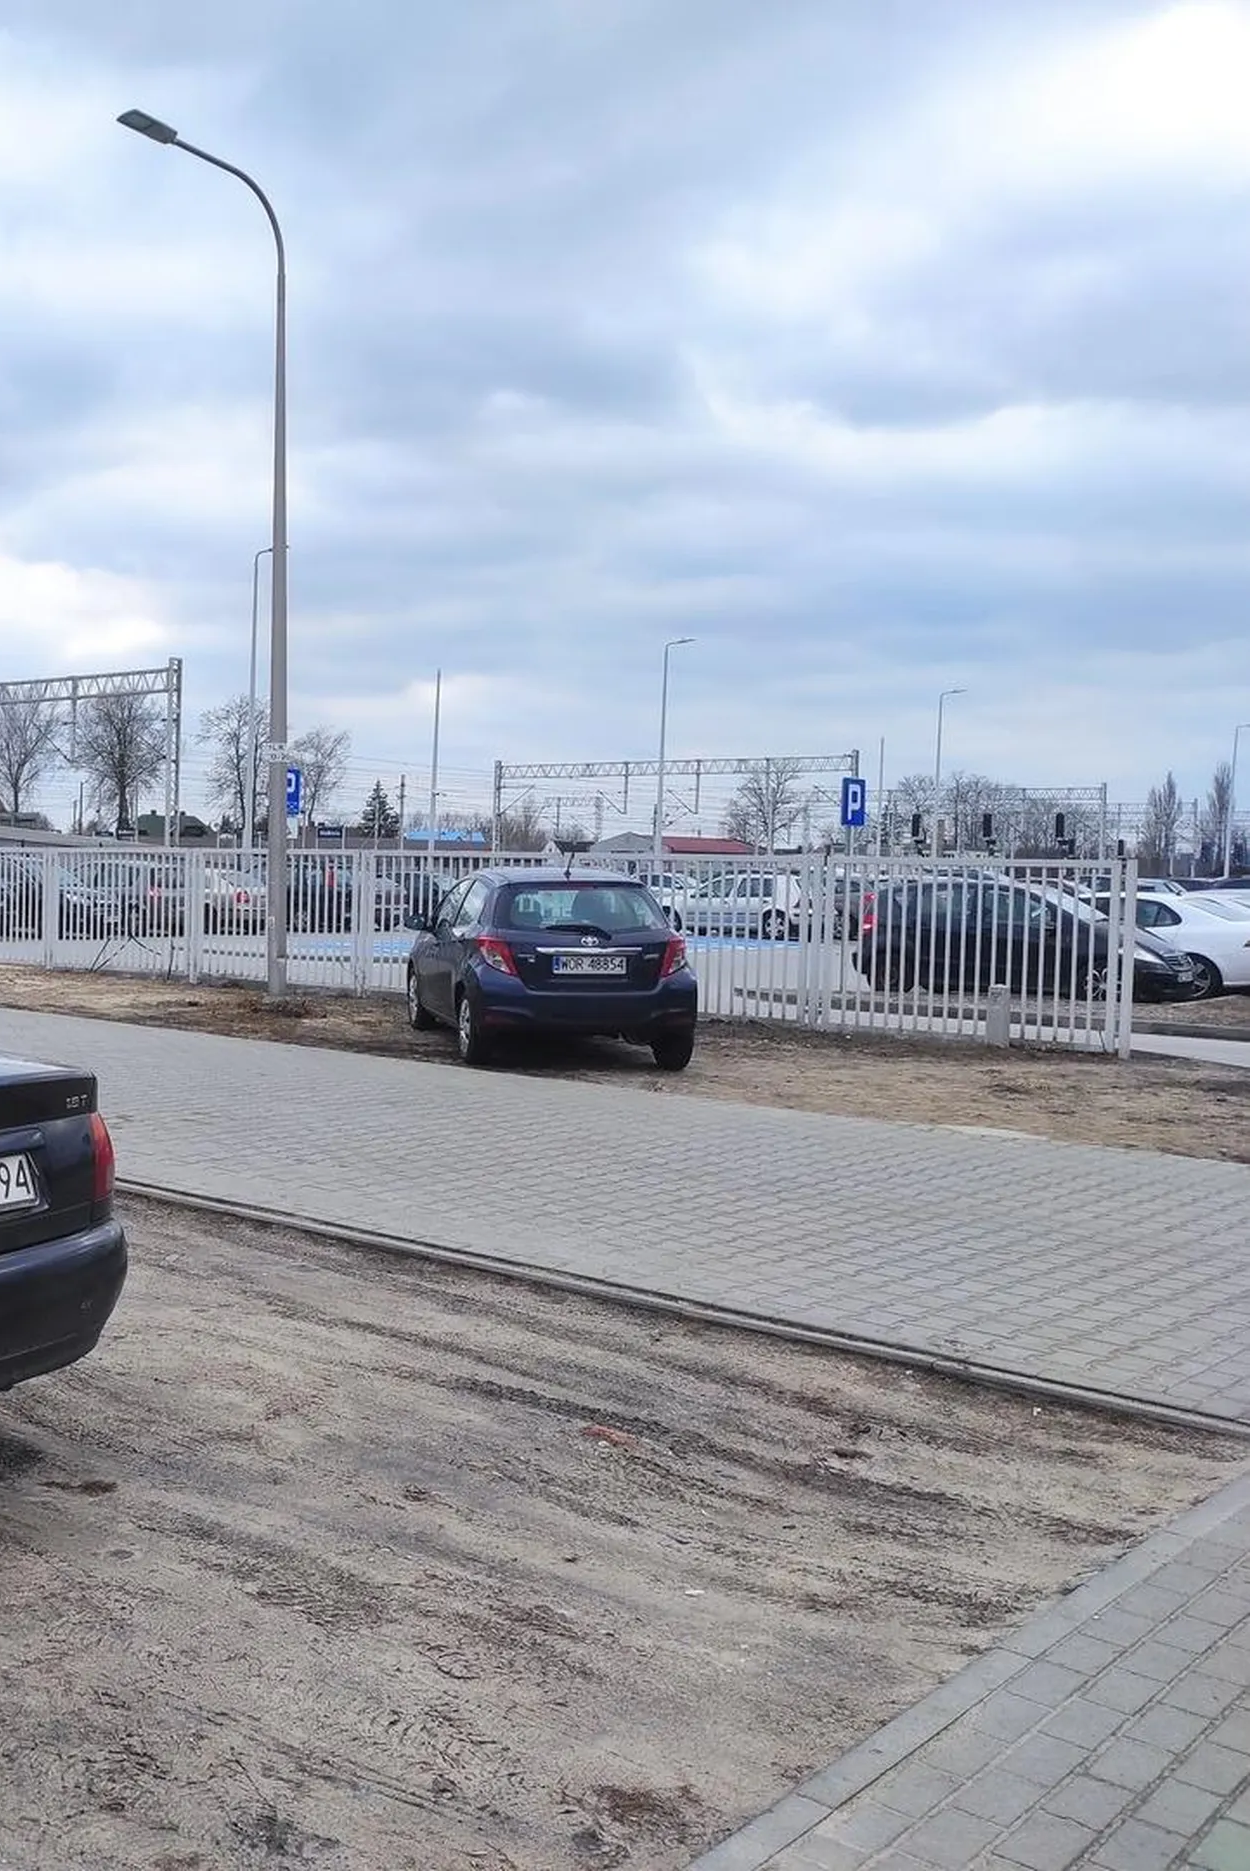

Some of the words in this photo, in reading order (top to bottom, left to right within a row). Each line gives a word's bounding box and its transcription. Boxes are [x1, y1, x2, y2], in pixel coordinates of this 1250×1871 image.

[847, 783, 862, 821] P
[562, 957, 584, 971] WOR
[587, 957, 624, 971] 48854
